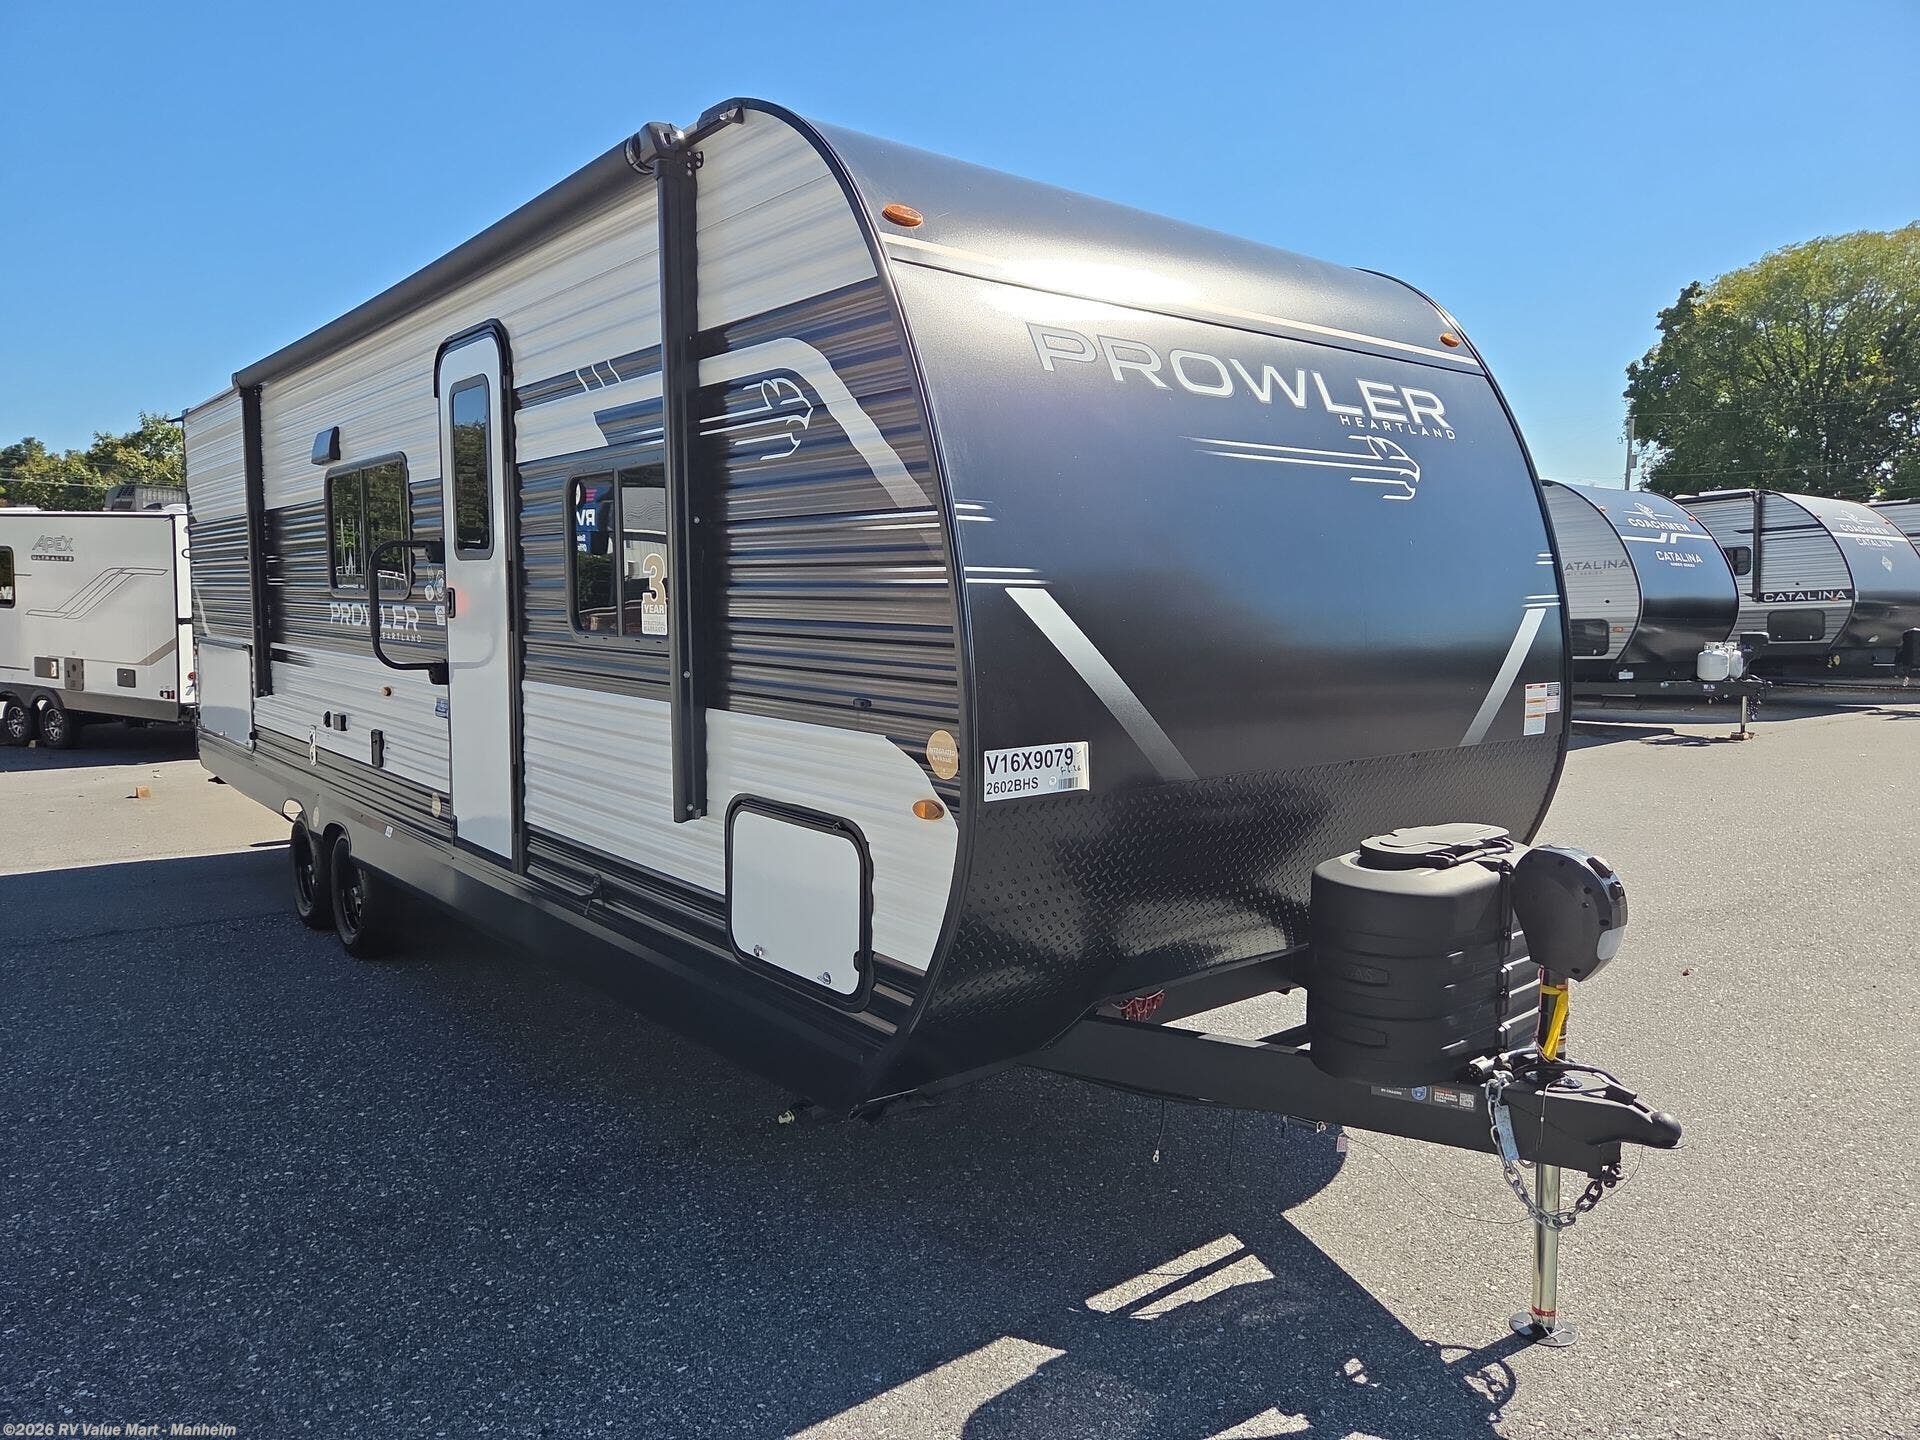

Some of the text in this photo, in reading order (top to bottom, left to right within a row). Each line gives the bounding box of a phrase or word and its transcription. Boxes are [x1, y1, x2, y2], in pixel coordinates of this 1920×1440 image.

[1025, 321, 1456, 430] PROWLER
[1339, 415, 1456, 440] HEARTLAND
[1628, 518, 1691, 532] COACHMEN
[32, 535, 73, 552] APEX
[1655, 551, 1703, 563] CATALINA
[1565, 560, 1630, 571] ATALINA
[643, 553, 666, 602] 3
[1763, 591, 1847, 602] CATALINA
[644, 604, 665, 614] YEAR
[380, 632, 421, 643] EARTLAND
[986, 748, 1073, 775] V16X9079
[986, 777, 1039, 795] 2602BHS
